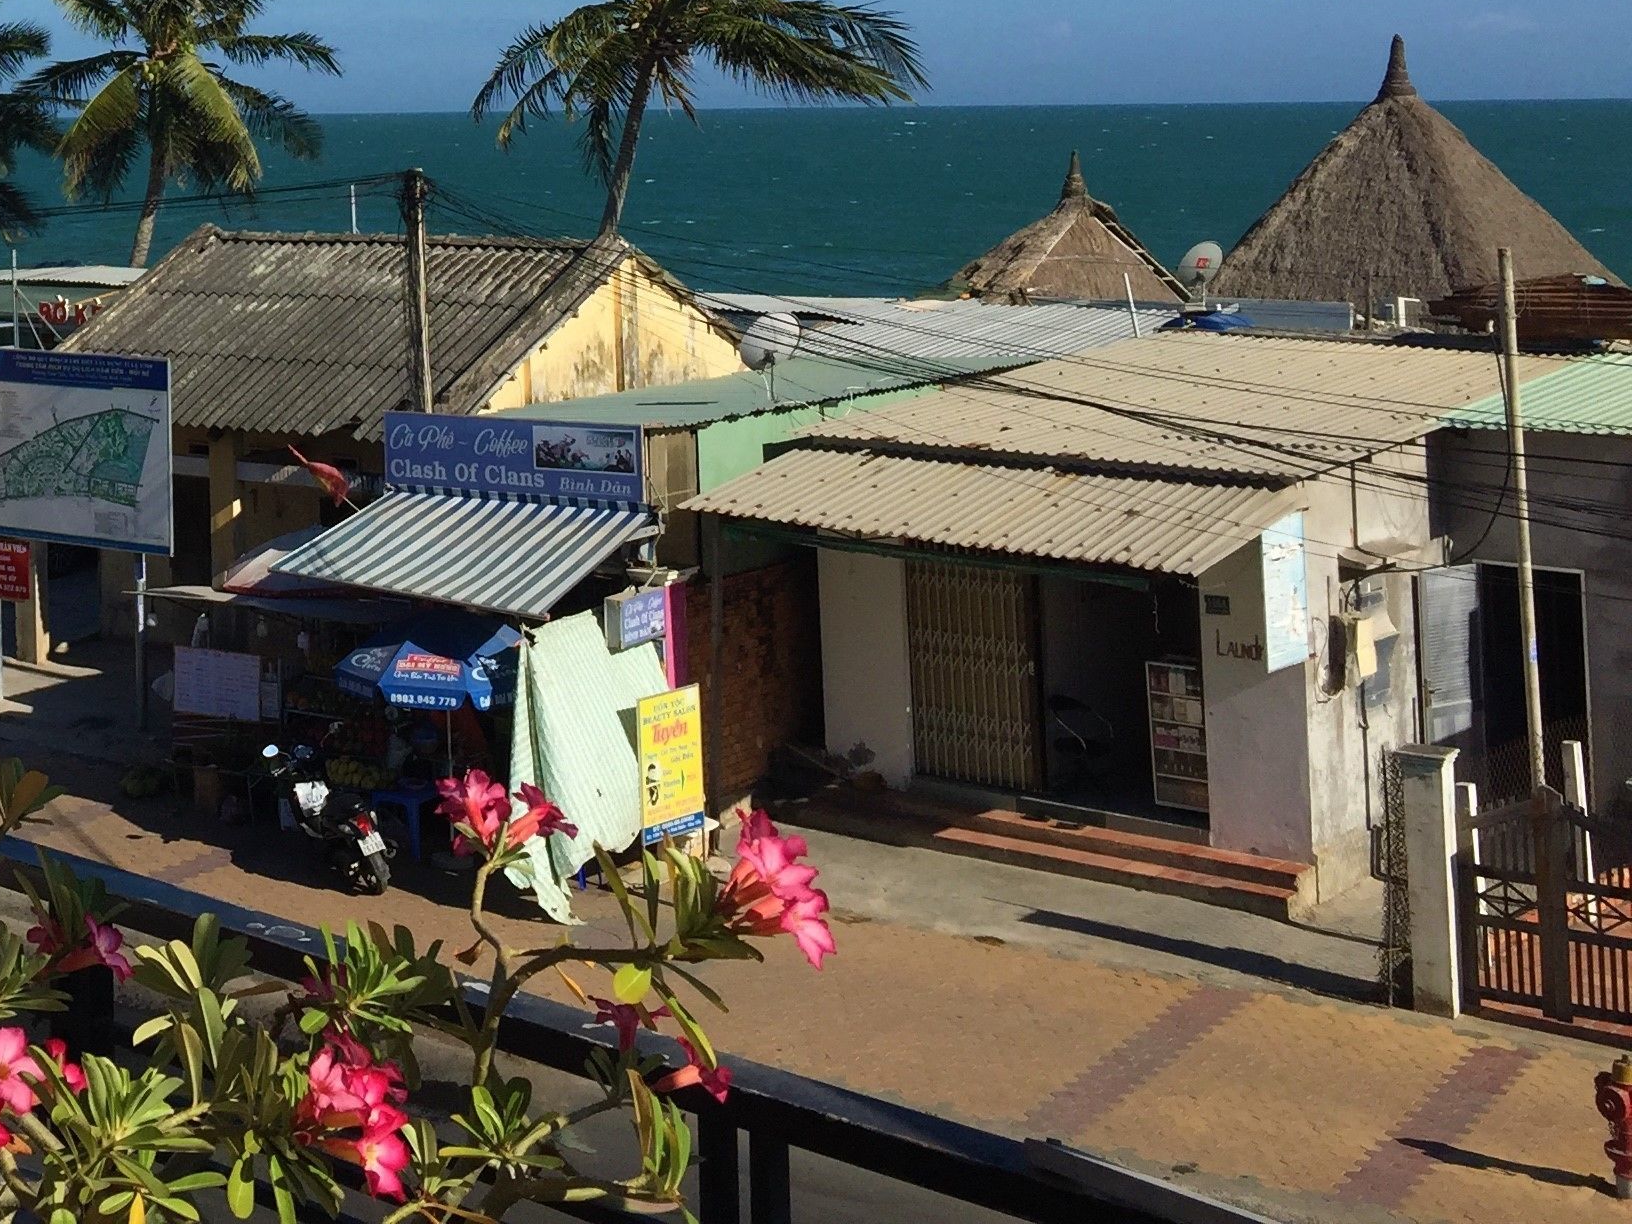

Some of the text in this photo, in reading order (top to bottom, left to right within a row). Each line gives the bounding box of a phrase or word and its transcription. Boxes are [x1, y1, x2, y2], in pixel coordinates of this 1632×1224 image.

[473, 428, 529, 459] Coffee
[390, 458, 545, 488] Clash Of Clans
